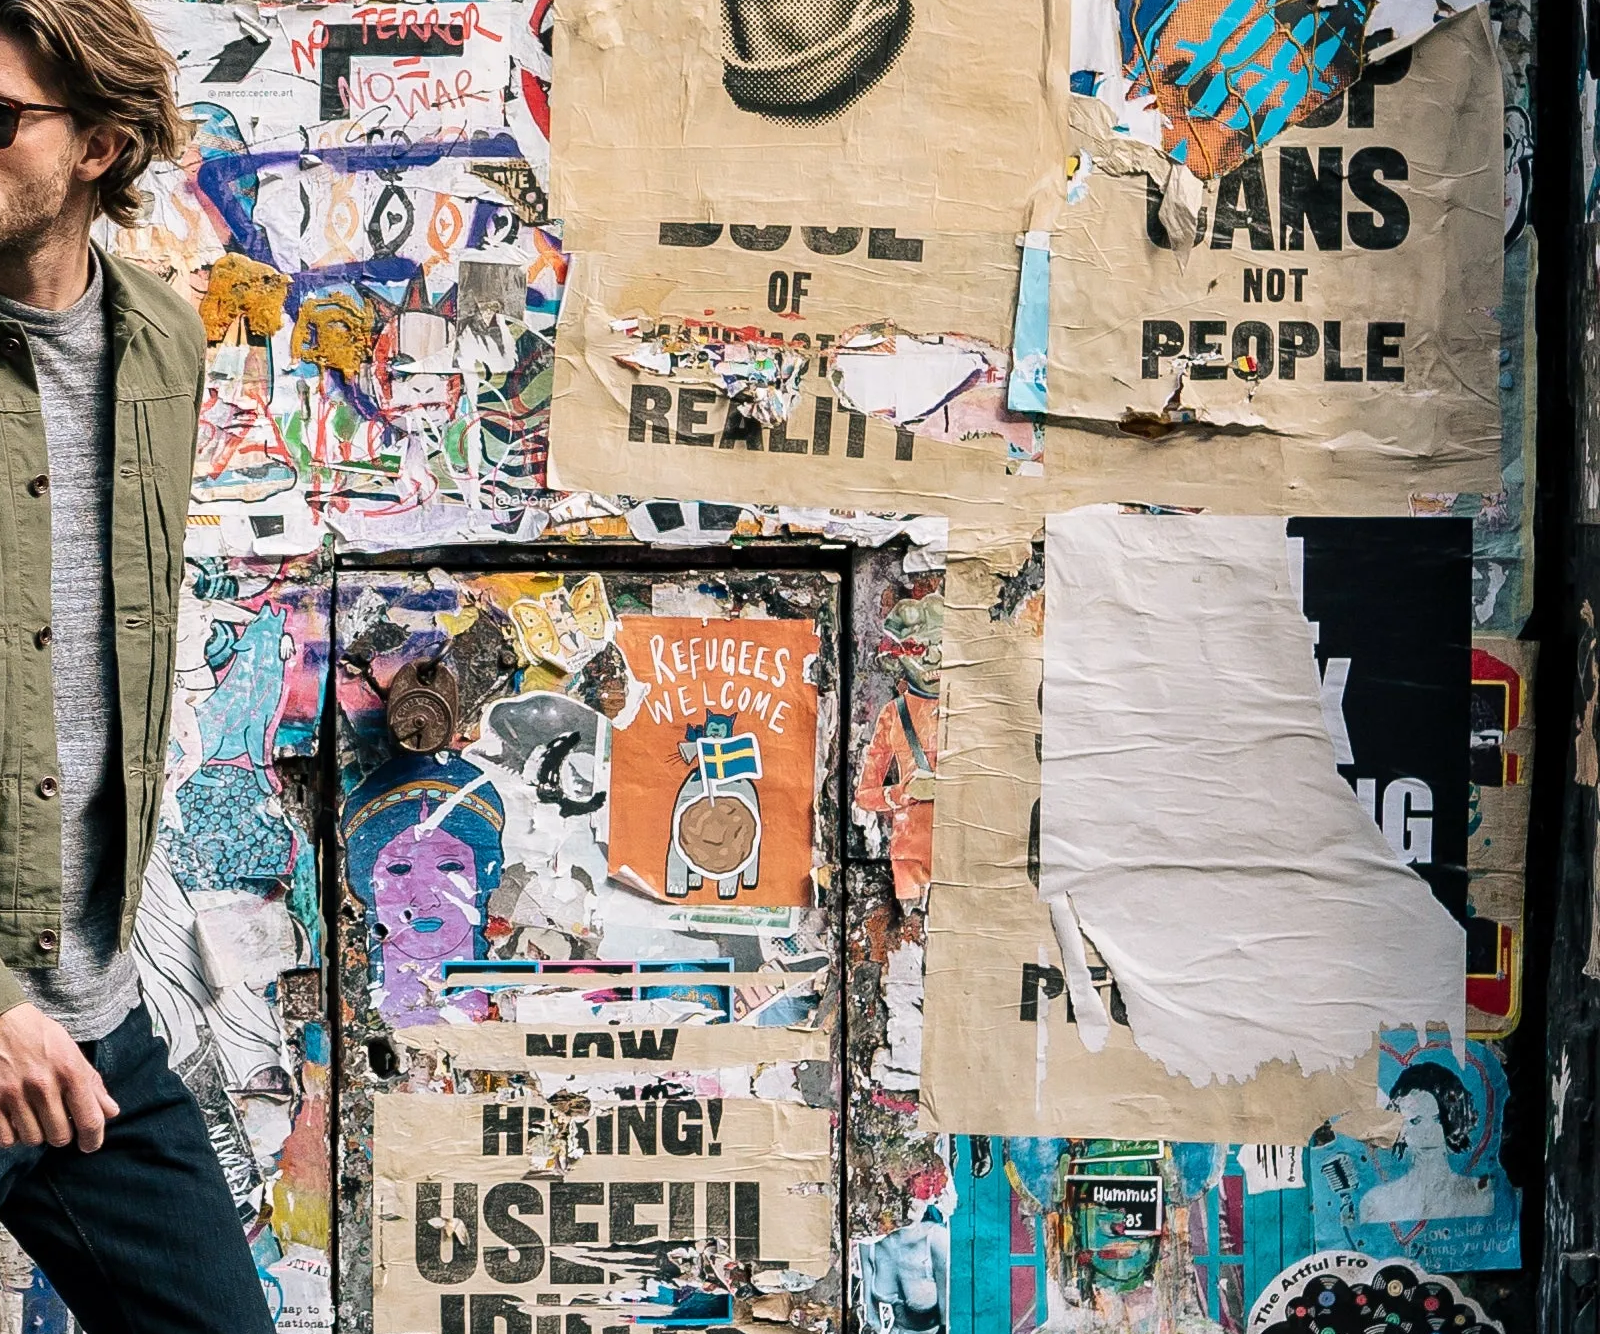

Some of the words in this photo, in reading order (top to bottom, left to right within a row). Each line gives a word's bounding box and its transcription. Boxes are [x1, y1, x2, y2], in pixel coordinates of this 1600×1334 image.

[292, 19, 330, 75] NO
[352, 3, 503, 47] TERROR
[338, 70, 394, 110] NO
[395, 70, 491, 118] WAR
[768, 270, 812, 314] OF
[1243, 268, 1309, 303] NOT
[1141, 320, 1406, 383] PEOPLE
[649, 634, 791, 688] REFUGEES
[644, 680, 792, 734] WELCOME
[1093, 1186, 1157, 1203] Hummus
[1254, 1293, 1280, 1326] The
[1282, 1258, 1329, 1291] Artful
[1336, 1255, 1369, 1269] Fro
